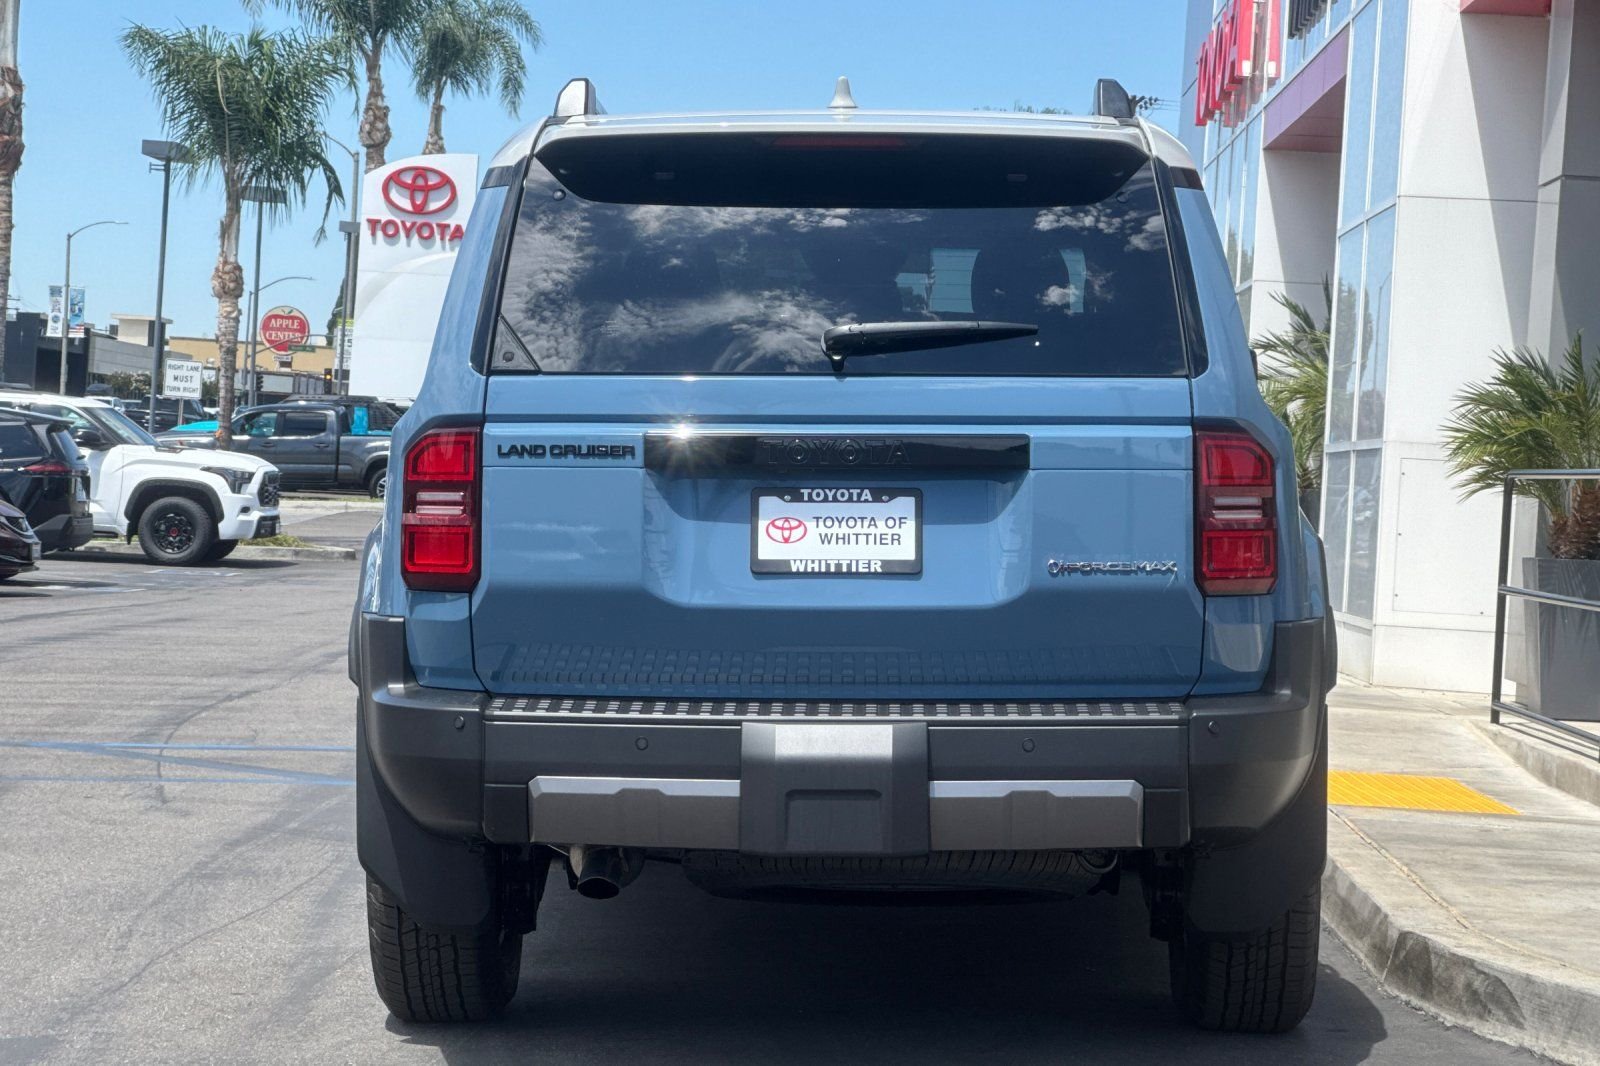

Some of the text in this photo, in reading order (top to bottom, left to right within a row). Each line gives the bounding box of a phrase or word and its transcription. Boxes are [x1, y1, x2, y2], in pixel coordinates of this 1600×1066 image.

[366, 218, 465, 242] TOYOTA
[269, 318, 300, 329] APPLE
[265, 331, 302, 342] CENTER
[167, 363, 201, 372] RIGHT LANE
[173, 374, 194, 383] MUST
[182, 386, 199, 394] RIGHT
[497, 444, 636, 459] LAND CRUISER
[762, 438, 912, 465] TOYOTA
[800, 488, 873, 502] TOYOTA
[812, 516, 908, 529] TOYOTA OF
[819, 533, 902, 546] WHITTIER
[789, 559, 883, 573] WHITTIER
[1133, 559, 1177, 571] MAX
